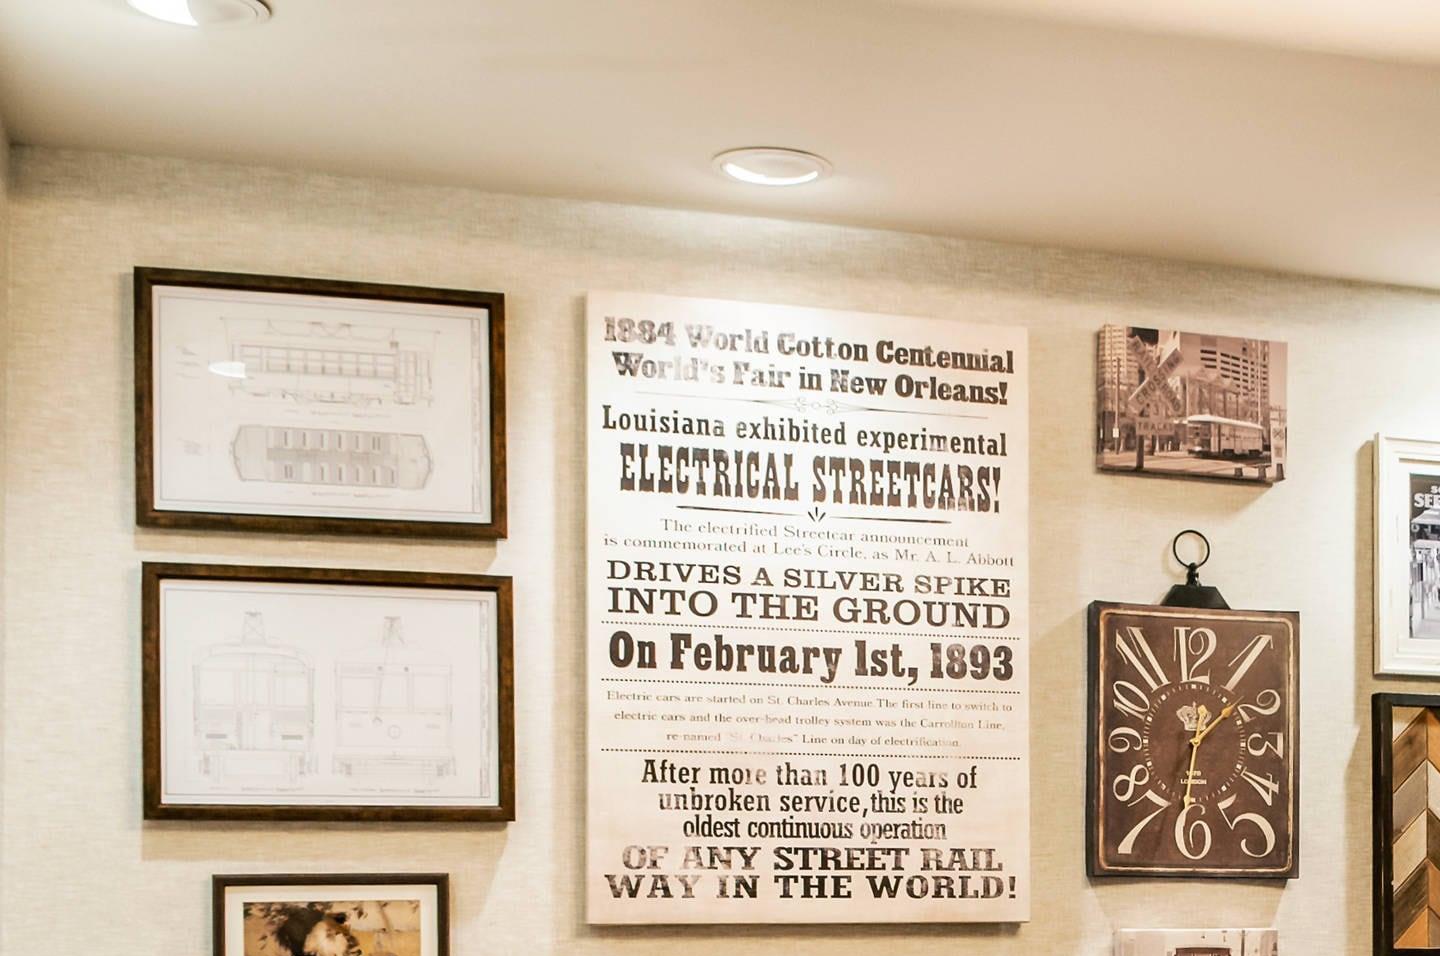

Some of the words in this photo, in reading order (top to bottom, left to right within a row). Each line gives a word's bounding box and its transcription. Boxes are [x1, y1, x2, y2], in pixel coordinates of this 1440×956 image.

[604, 317, 675, 346] 1884
[685, 324, 769, 354] World
[777, 333, 868, 362] Cotton
[876, 341, 1014, 374] Centennial
[612, 351, 725, 383] World's
[733, 361, 791, 388] Fair
[799, 367, 822, 391] in
[830, 369, 887, 395] New
[895, 374, 1007, 405] Orleans!
[603, 405, 724, 437] Louisiana
[736, 416, 846, 445] exhibited
[857, 428, 1007, 456] experimental
[621, 443, 799, 501] ELECTRICAL
[813, 456, 1000, 513] STREETCARS!
[604, 534, 617, 545] is
[624, 537, 746, 552] commemorated
[753, 544, 766, 553] at
[774, 542, 812, 556] Lee's
[818, 546, 867, 559] Circle,
[872, 552, 888, 560] as
[895, 549, 919, 561] Mr.
[926, 551, 940, 562] A.
[947, 552, 960, 563] L.
[967, 552, 1014, 567] Abbott
[660, 519, 692, 532] The
[698, 522, 777, 537] electrified
[784, 525, 853, 541] Streetcar
[861, 533, 968, 547] announcement
[607, 560, 741, 585] DRIVES
[751, 568, 774, 586] A
[784, 569, 904, 593] SILVER
[914, 575, 1010, 598] SPIKE
[608, 587, 718, 616] INTO
[732, 592, 818, 621] THE
[833, 597, 1010, 629] GROUND
[609, 630, 657, 669] On
[670, 633, 842, 683] February
[855, 640, 919, 685] 1st,
[930, 643, 1013, 681] 1893
[1116, 626, 1171, 693] 11
[1174, 627, 1217, 685] 12
[1221, 634, 1273, 694] 1
[607, 690, 652, 700] Electric
[656, 693, 680, 702] cars
[706, 694, 746, 704] started
[787, 695, 829, 706] Charles
[877, 699, 897, 708] The
[902, 700, 924, 709] first
[928, 701, 948, 709] line
[951, 702, 961, 710] to
[965, 702, 999, 711] switch
[1003, 704, 1012, 712] to
[614, 711, 656, 721] electric
[661, 713, 685, 721] cars
[690, 713, 710, 722] and
[715, 713, 732, 722] the
[736, 715, 791, 725] over-head
[796, 715, 829, 726] trolley
[834, 718, 871, 727] system
[900, 719, 917, 728] the
[1113, 680, 1149, 721] 10
[1237, 689, 1280, 723] 2
[803, 735, 827, 744] Line
[848, 736, 867, 747] day
[871, 736, 882, 745] of
[1108, 727, 1142, 753] 9
[1247, 731, 1284, 759] 3
[642, 759, 701, 784] After
[709, 767, 767, 785] more
[776, 763, 828, 786] than
[839, 763, 879, 786] 100
[888, 769, 948, 794] years
[957, 766, 977, 788] of
[1113, 764, 1149, 801] 8
[1240, 766, 1279, 806] 4
[659, 787, 770, 811] unbroken
[913, 792, 928, 813] is
[935, 792, 963, 814] the
[683, 814, 740, 838] oldest
[748, 816, 853, 839] continuous
[860, 818, 947, 844] operation
[1118, 789, 1172, 854] 7
[1175, 804, 1212, 859] 6
[1218, 793, 1275, 858] 5
[622, 846, 668, 870] OF
[680, 847, 761, 870] ANY
[774, 847, 909, 870] STREET
[920, 848, 1003, 871] RAIL
[604, 874, 702, 898] WAY
[717, 875, 759, 898] IN
[774, 875, 851, 898] THE
[866, 875, 1016, 899] WORLD!
